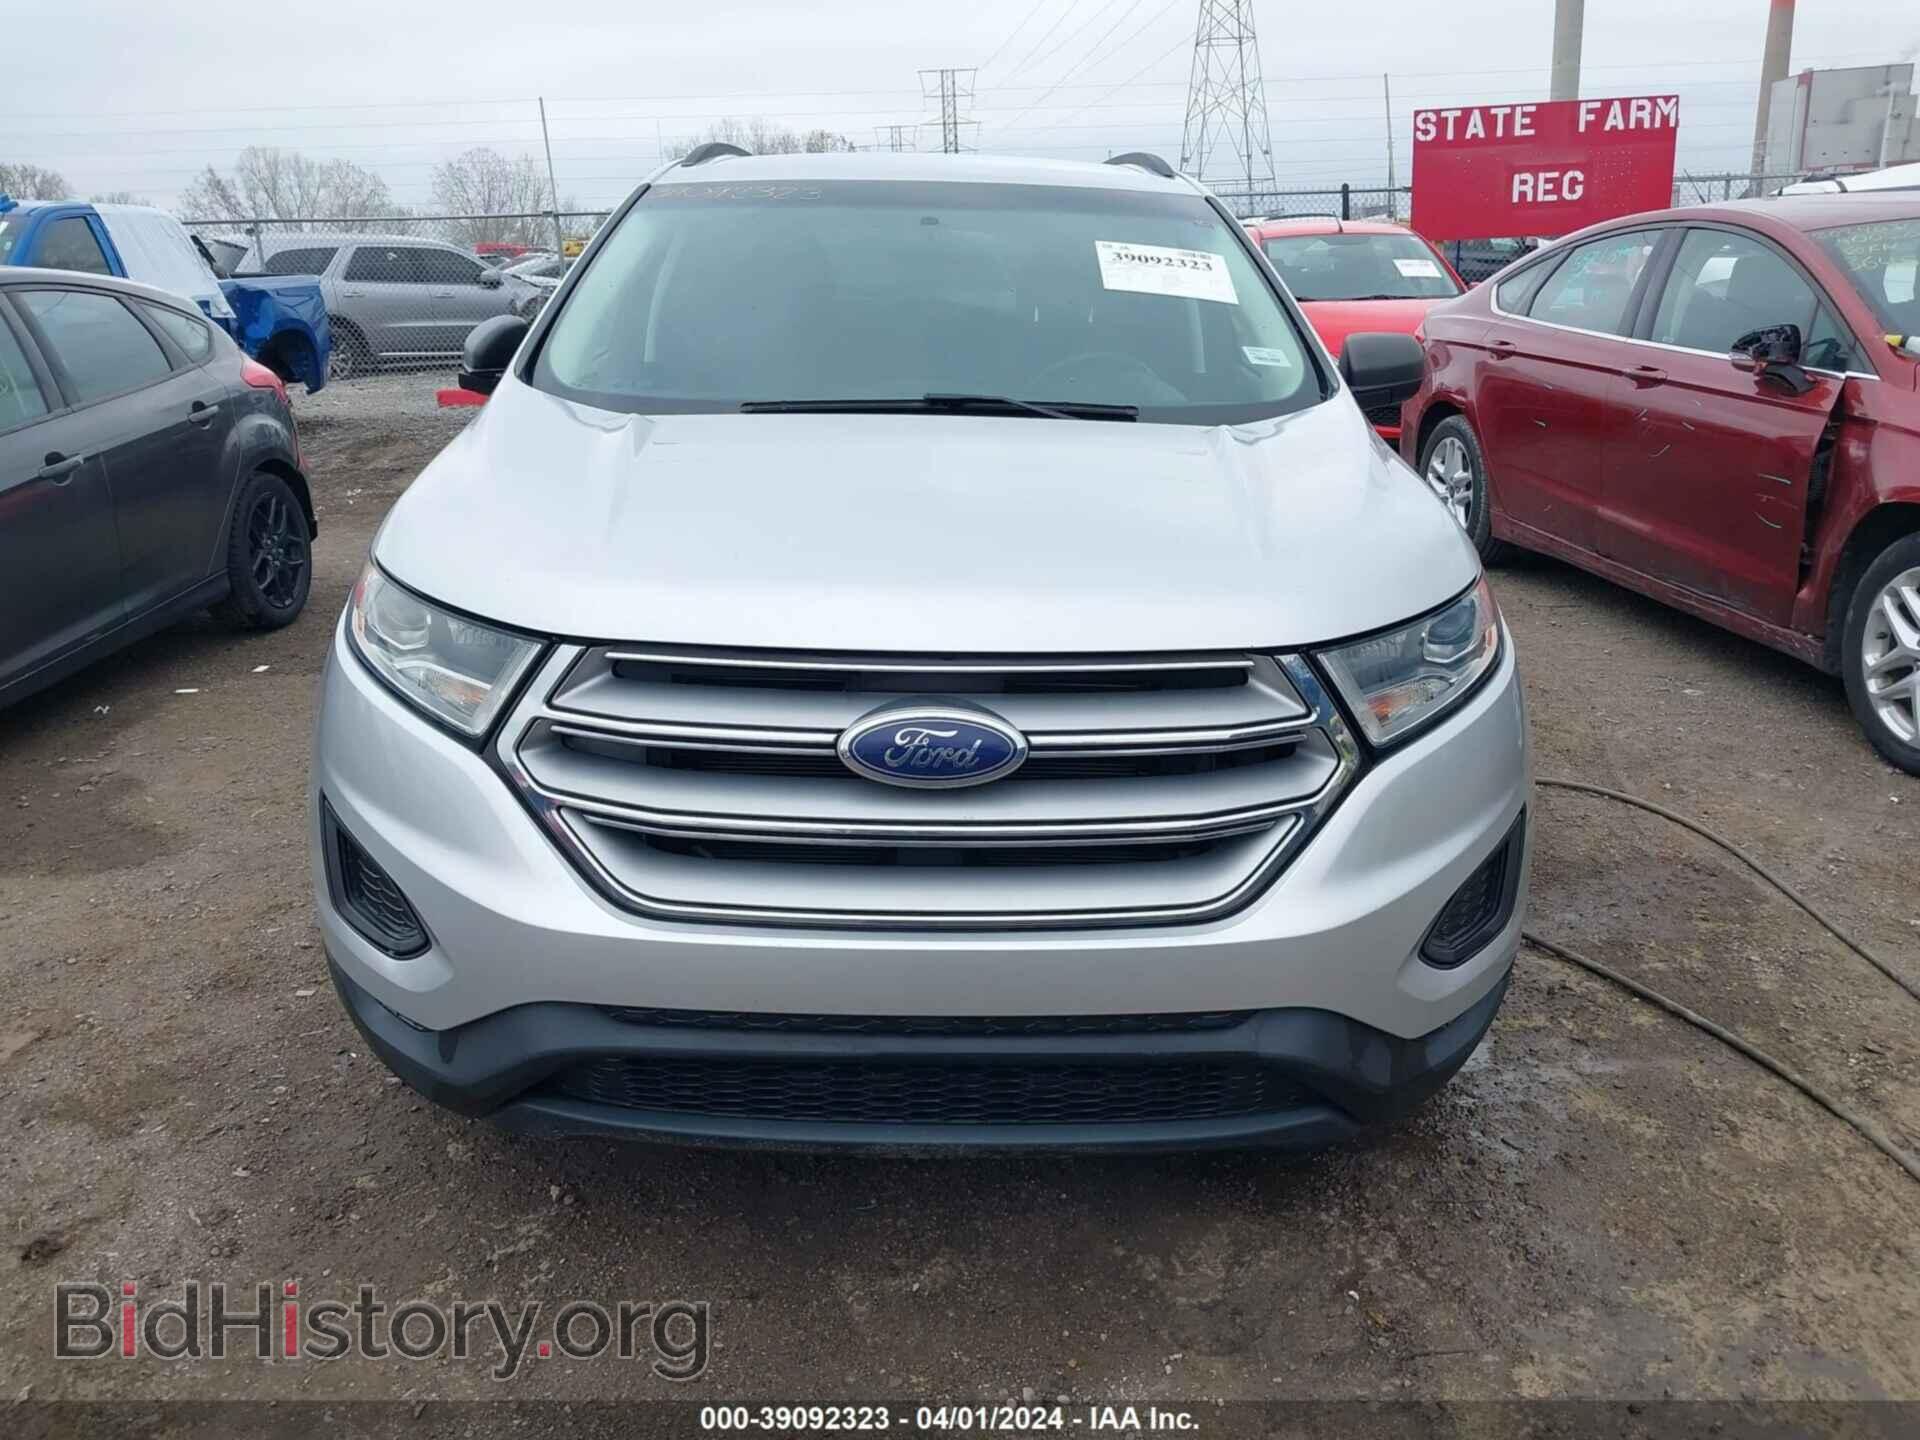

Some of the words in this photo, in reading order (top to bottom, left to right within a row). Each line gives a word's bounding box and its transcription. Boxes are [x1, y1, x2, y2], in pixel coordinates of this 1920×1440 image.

[1415, 105, 1537, 142] STATE
[1578, 96, 1678, 133] FARM
[1511, 170, 1585, 203] REG
[1111, 251, 1213, 271] 39092323
[884, 727, 983, 768] Ford
